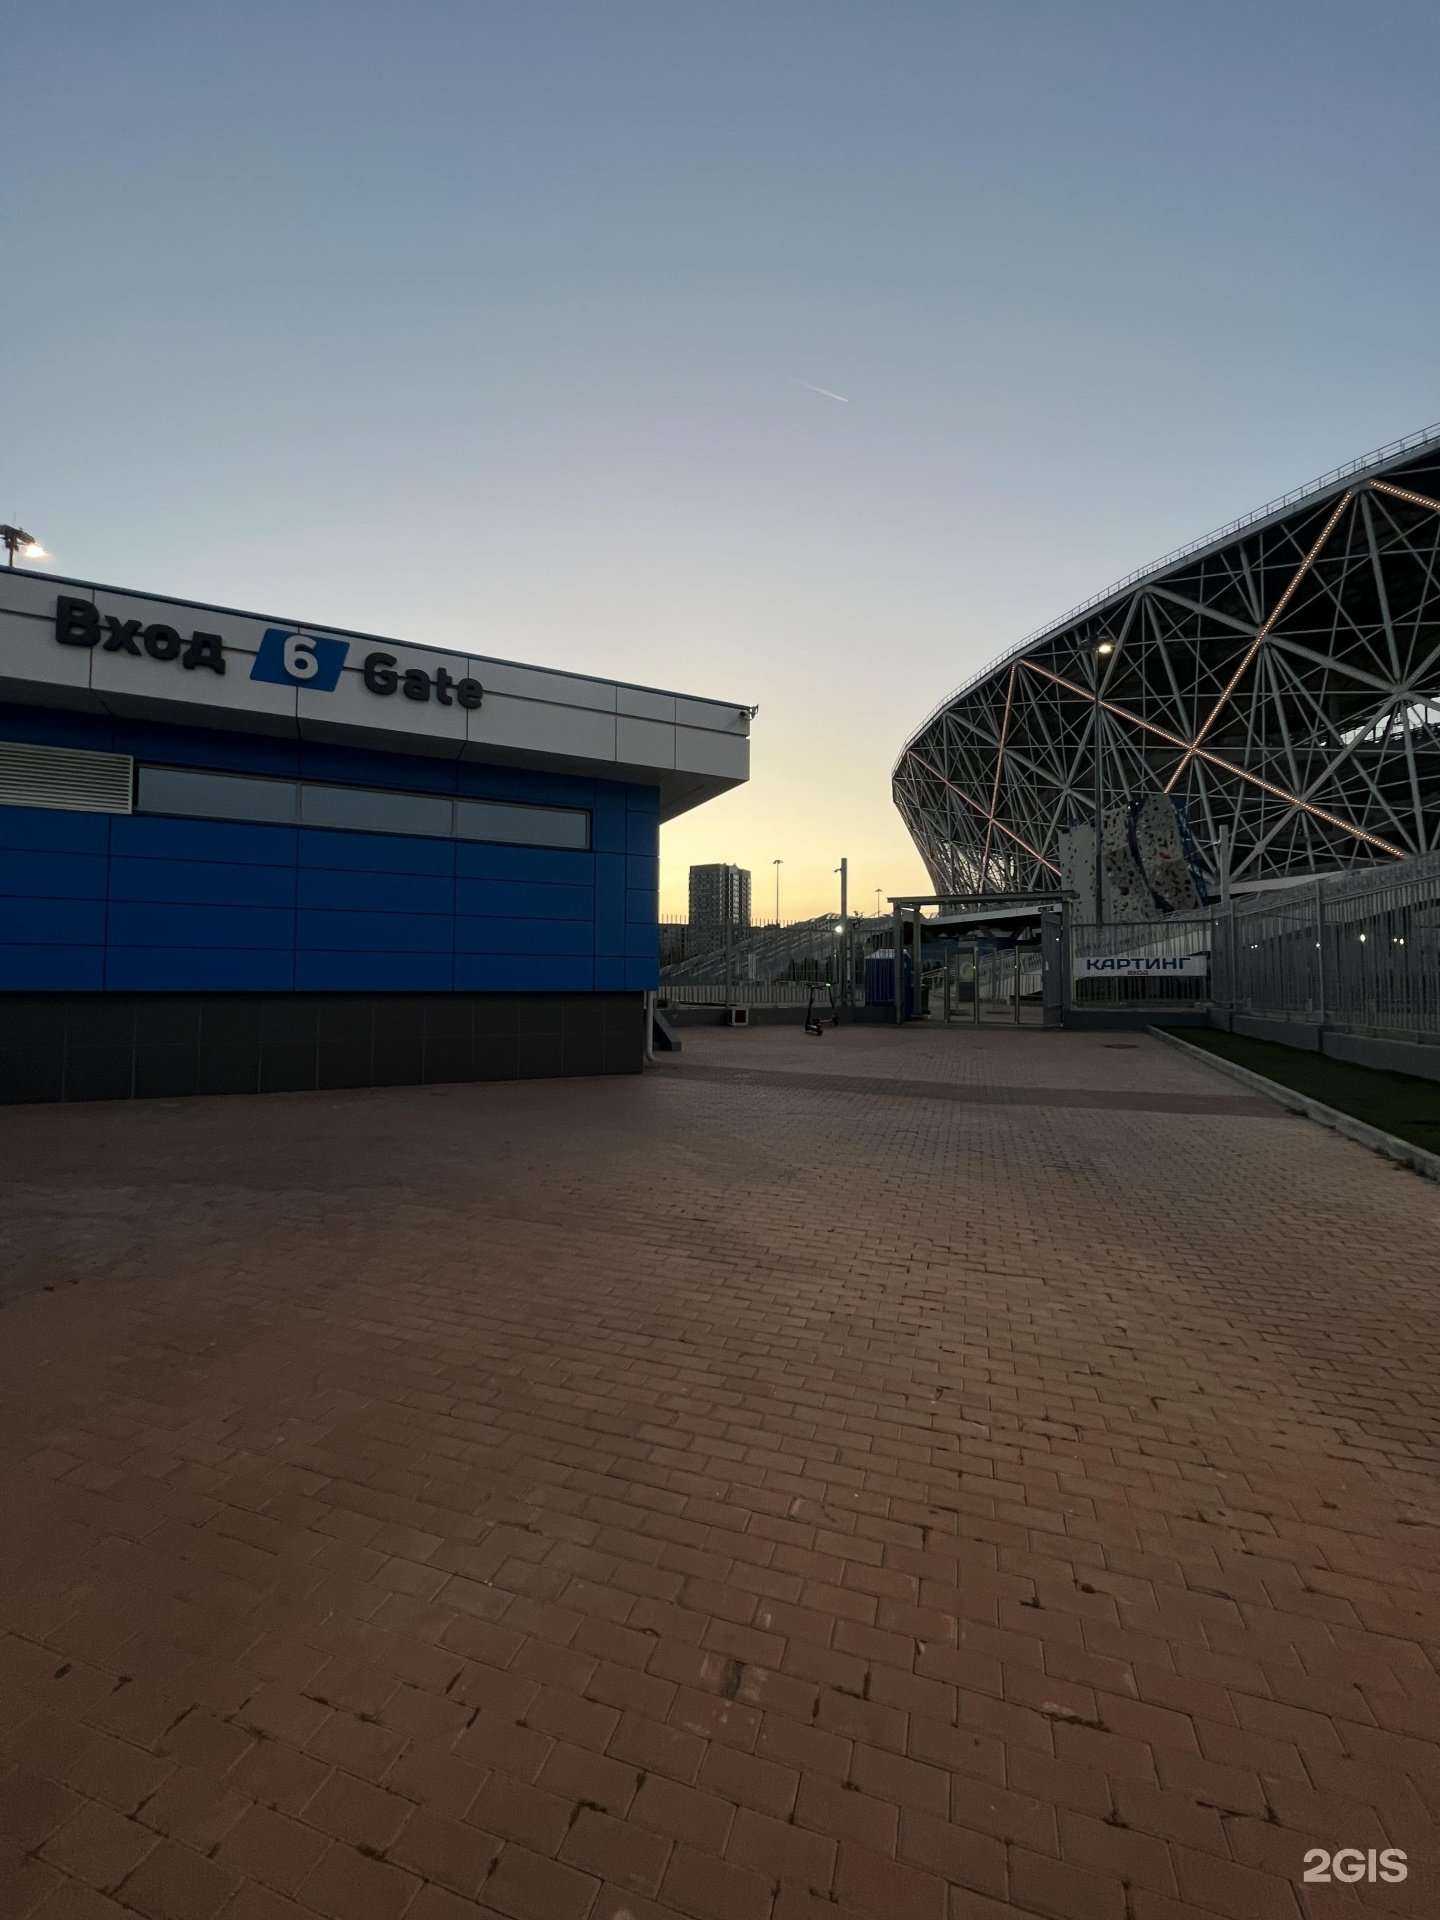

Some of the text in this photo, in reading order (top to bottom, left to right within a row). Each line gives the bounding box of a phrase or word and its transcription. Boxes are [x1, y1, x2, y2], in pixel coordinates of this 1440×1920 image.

[56, 595, 484, 709] Вход 6 Gate
[1087, 958, 1191, 970] КАРТИНГ
